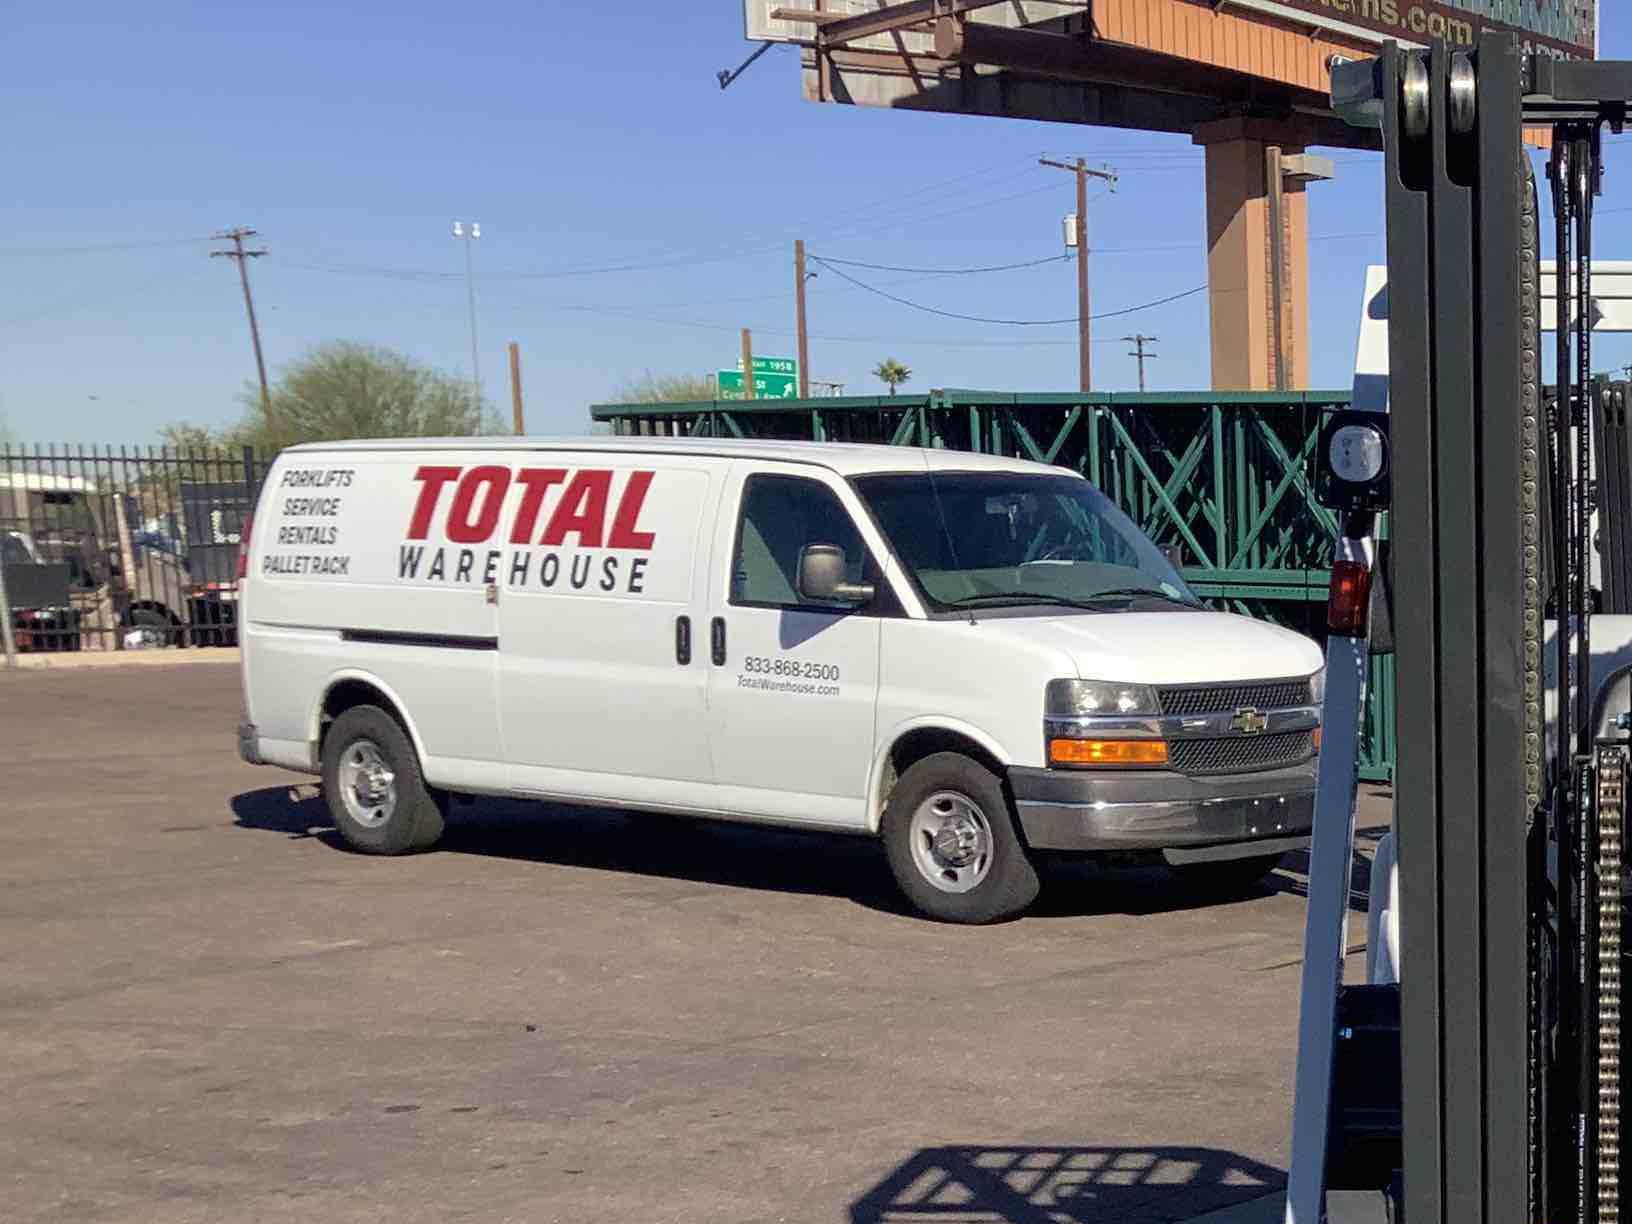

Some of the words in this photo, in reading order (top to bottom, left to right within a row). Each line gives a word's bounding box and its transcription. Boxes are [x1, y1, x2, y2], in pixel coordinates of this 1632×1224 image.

[281, 470, 354, 487] FORKLIFTS
[283, 498, 340, 516] SERVICE
[407, 465, 656, 550] TOTAL
[278, 526, 337, 544] RENTALS
[398, 545, 648, 593] WAREHOUSE
[744, 656, 840, 681] 833-868-2500
